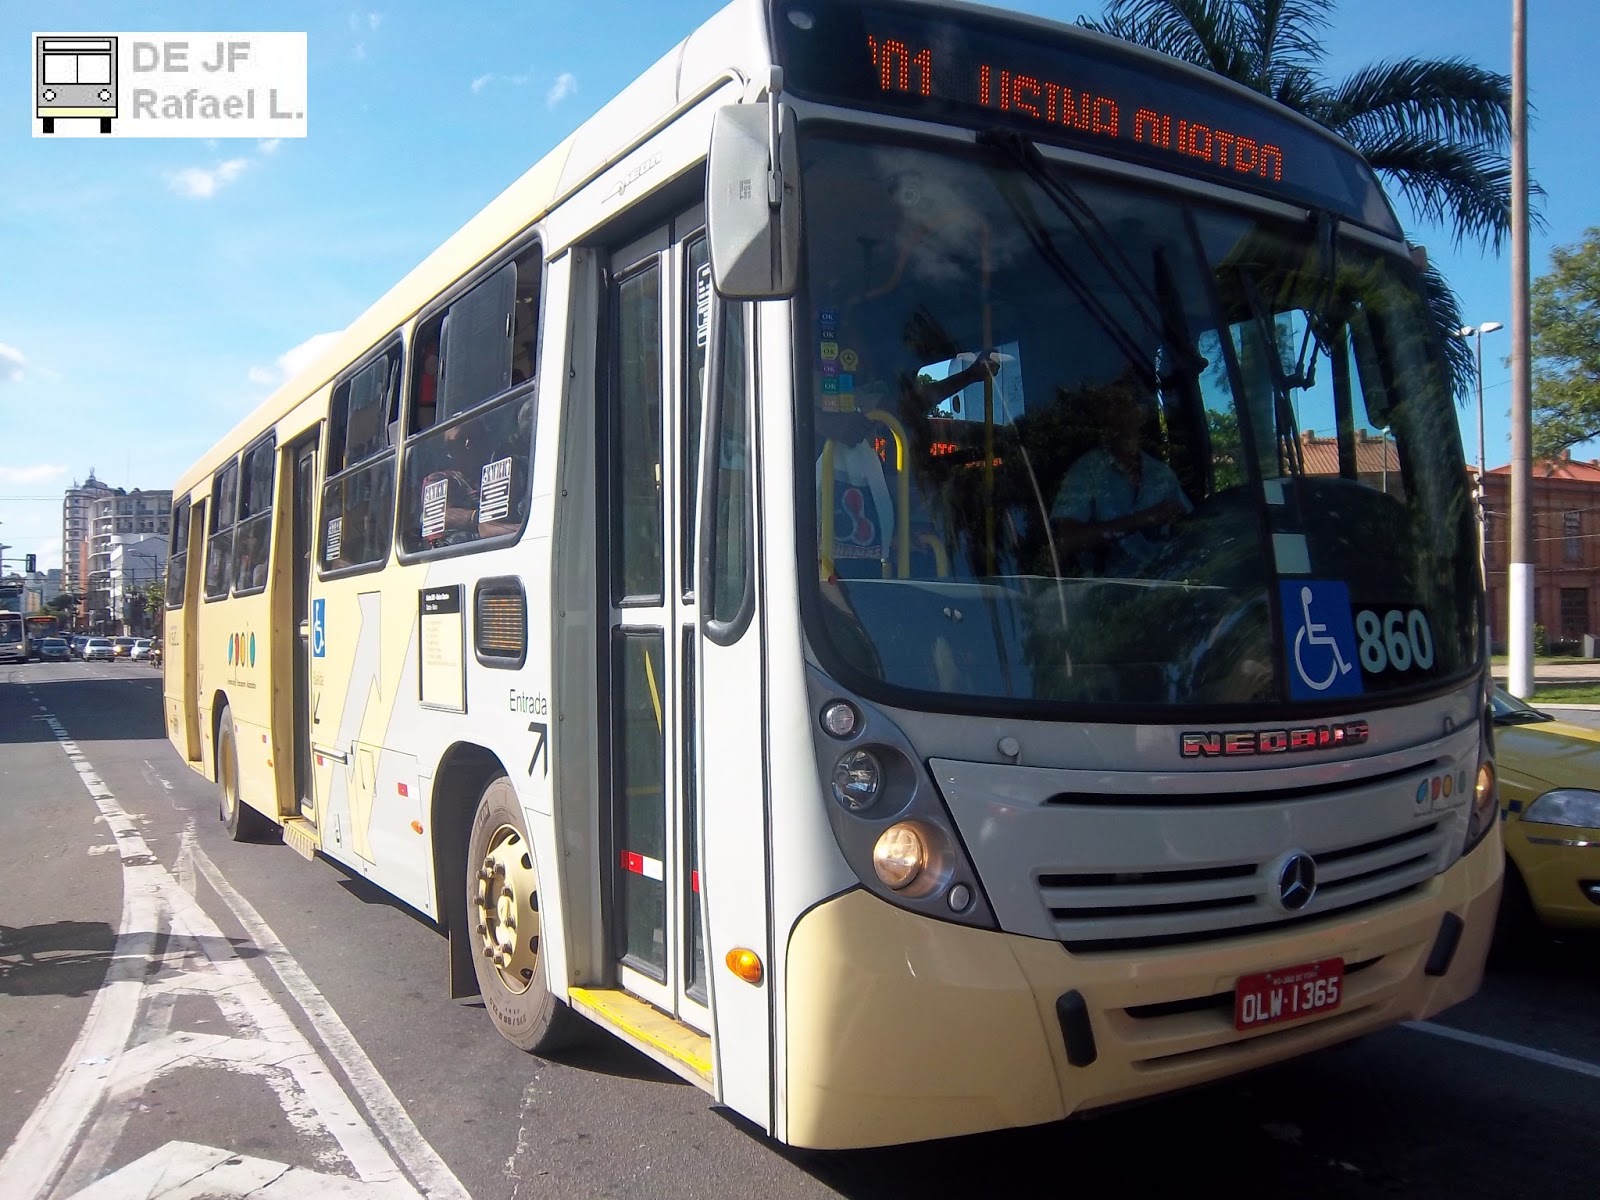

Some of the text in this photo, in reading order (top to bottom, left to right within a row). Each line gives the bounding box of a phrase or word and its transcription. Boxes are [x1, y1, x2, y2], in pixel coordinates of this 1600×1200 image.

[868, 34, 932, 96] 01
[821, 313, 834, 321] OK
[822, 331, 835, 339] OK
[1356, 609, 1434, 674] 860
[509, 688, 548, 716] Entrada
[1180, 719, 1369, 759] NEOBUS
